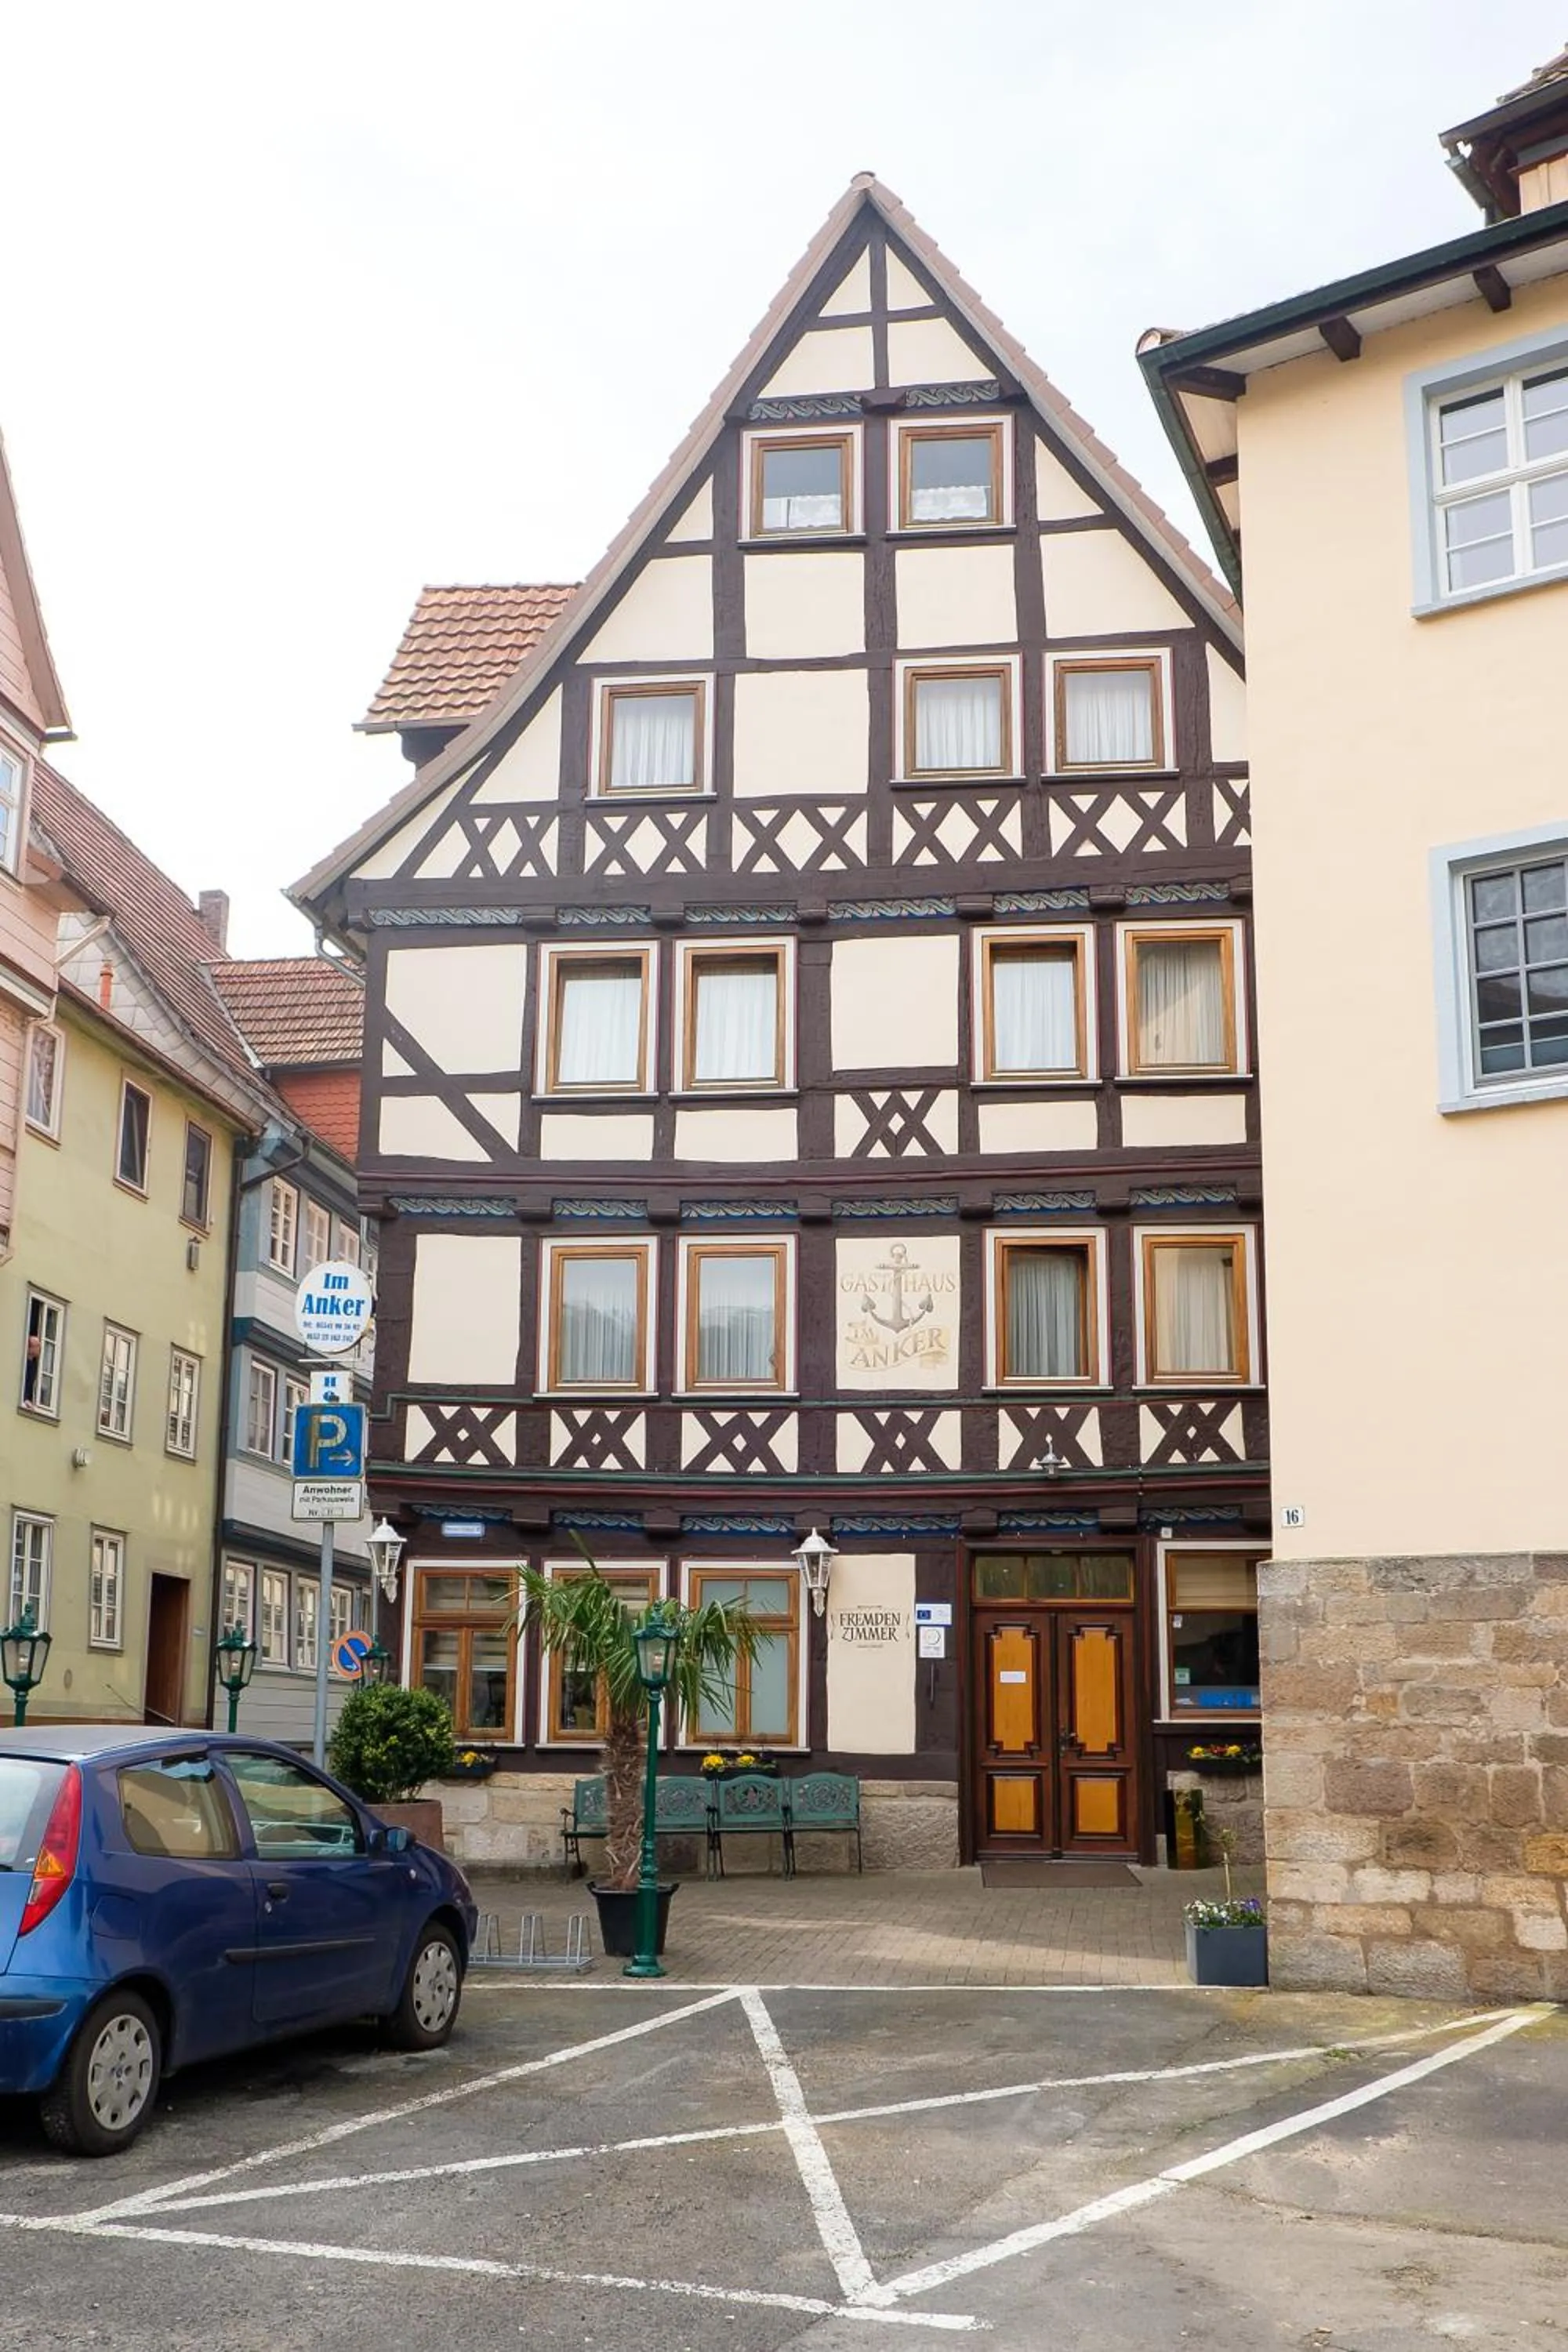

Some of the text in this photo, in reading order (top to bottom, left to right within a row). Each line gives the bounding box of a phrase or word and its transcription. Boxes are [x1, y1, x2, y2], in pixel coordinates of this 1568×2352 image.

[324, 1272, 349, 1290] Im
[302, 1293, 365, 1316] Anker
[850, 1327, 947, 1368] ANKER
[310, 1414, 347, 1468] P
[303, 1485, 352, 1494] Anwohner
[1287, 1509, 1299, 1525] 16
[840, 1613, 901, 1627] FREMDEN
[841, 1627, 898, 1642] ZIMMER
